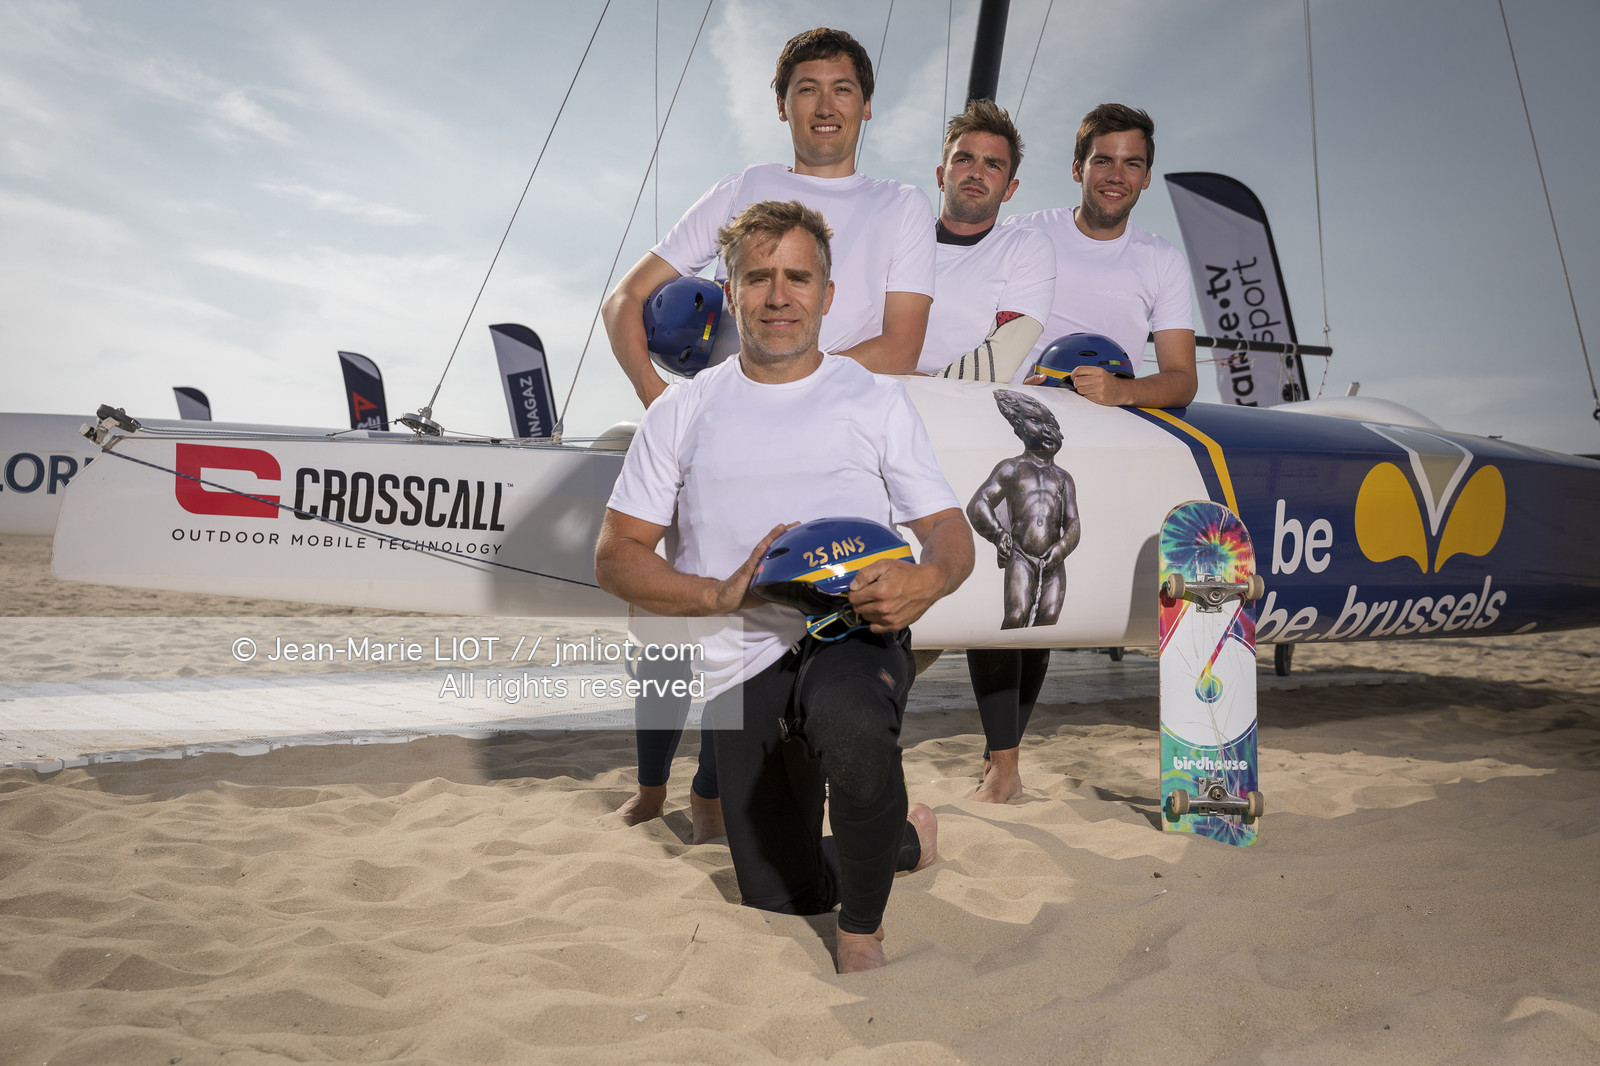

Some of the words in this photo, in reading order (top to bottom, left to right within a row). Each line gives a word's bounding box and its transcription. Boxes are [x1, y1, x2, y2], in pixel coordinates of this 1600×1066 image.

[1232, 256, 1281, 343] sport
[0, 452, 94, 494] OR
[294, 467, 505, 531] CROSSCALL
[172, 528, 280, 545] OUTDOOR
[291, 534, 366, 549] MOBILE
[378, 538, 502, 555] TECHNOLOGY
[802, 546, 829, 568] 25
[832, 536, 865, 560] ANS
[1272, 499, 1333, 575] be
[1173, 756, 1248, 771] birdhouse
